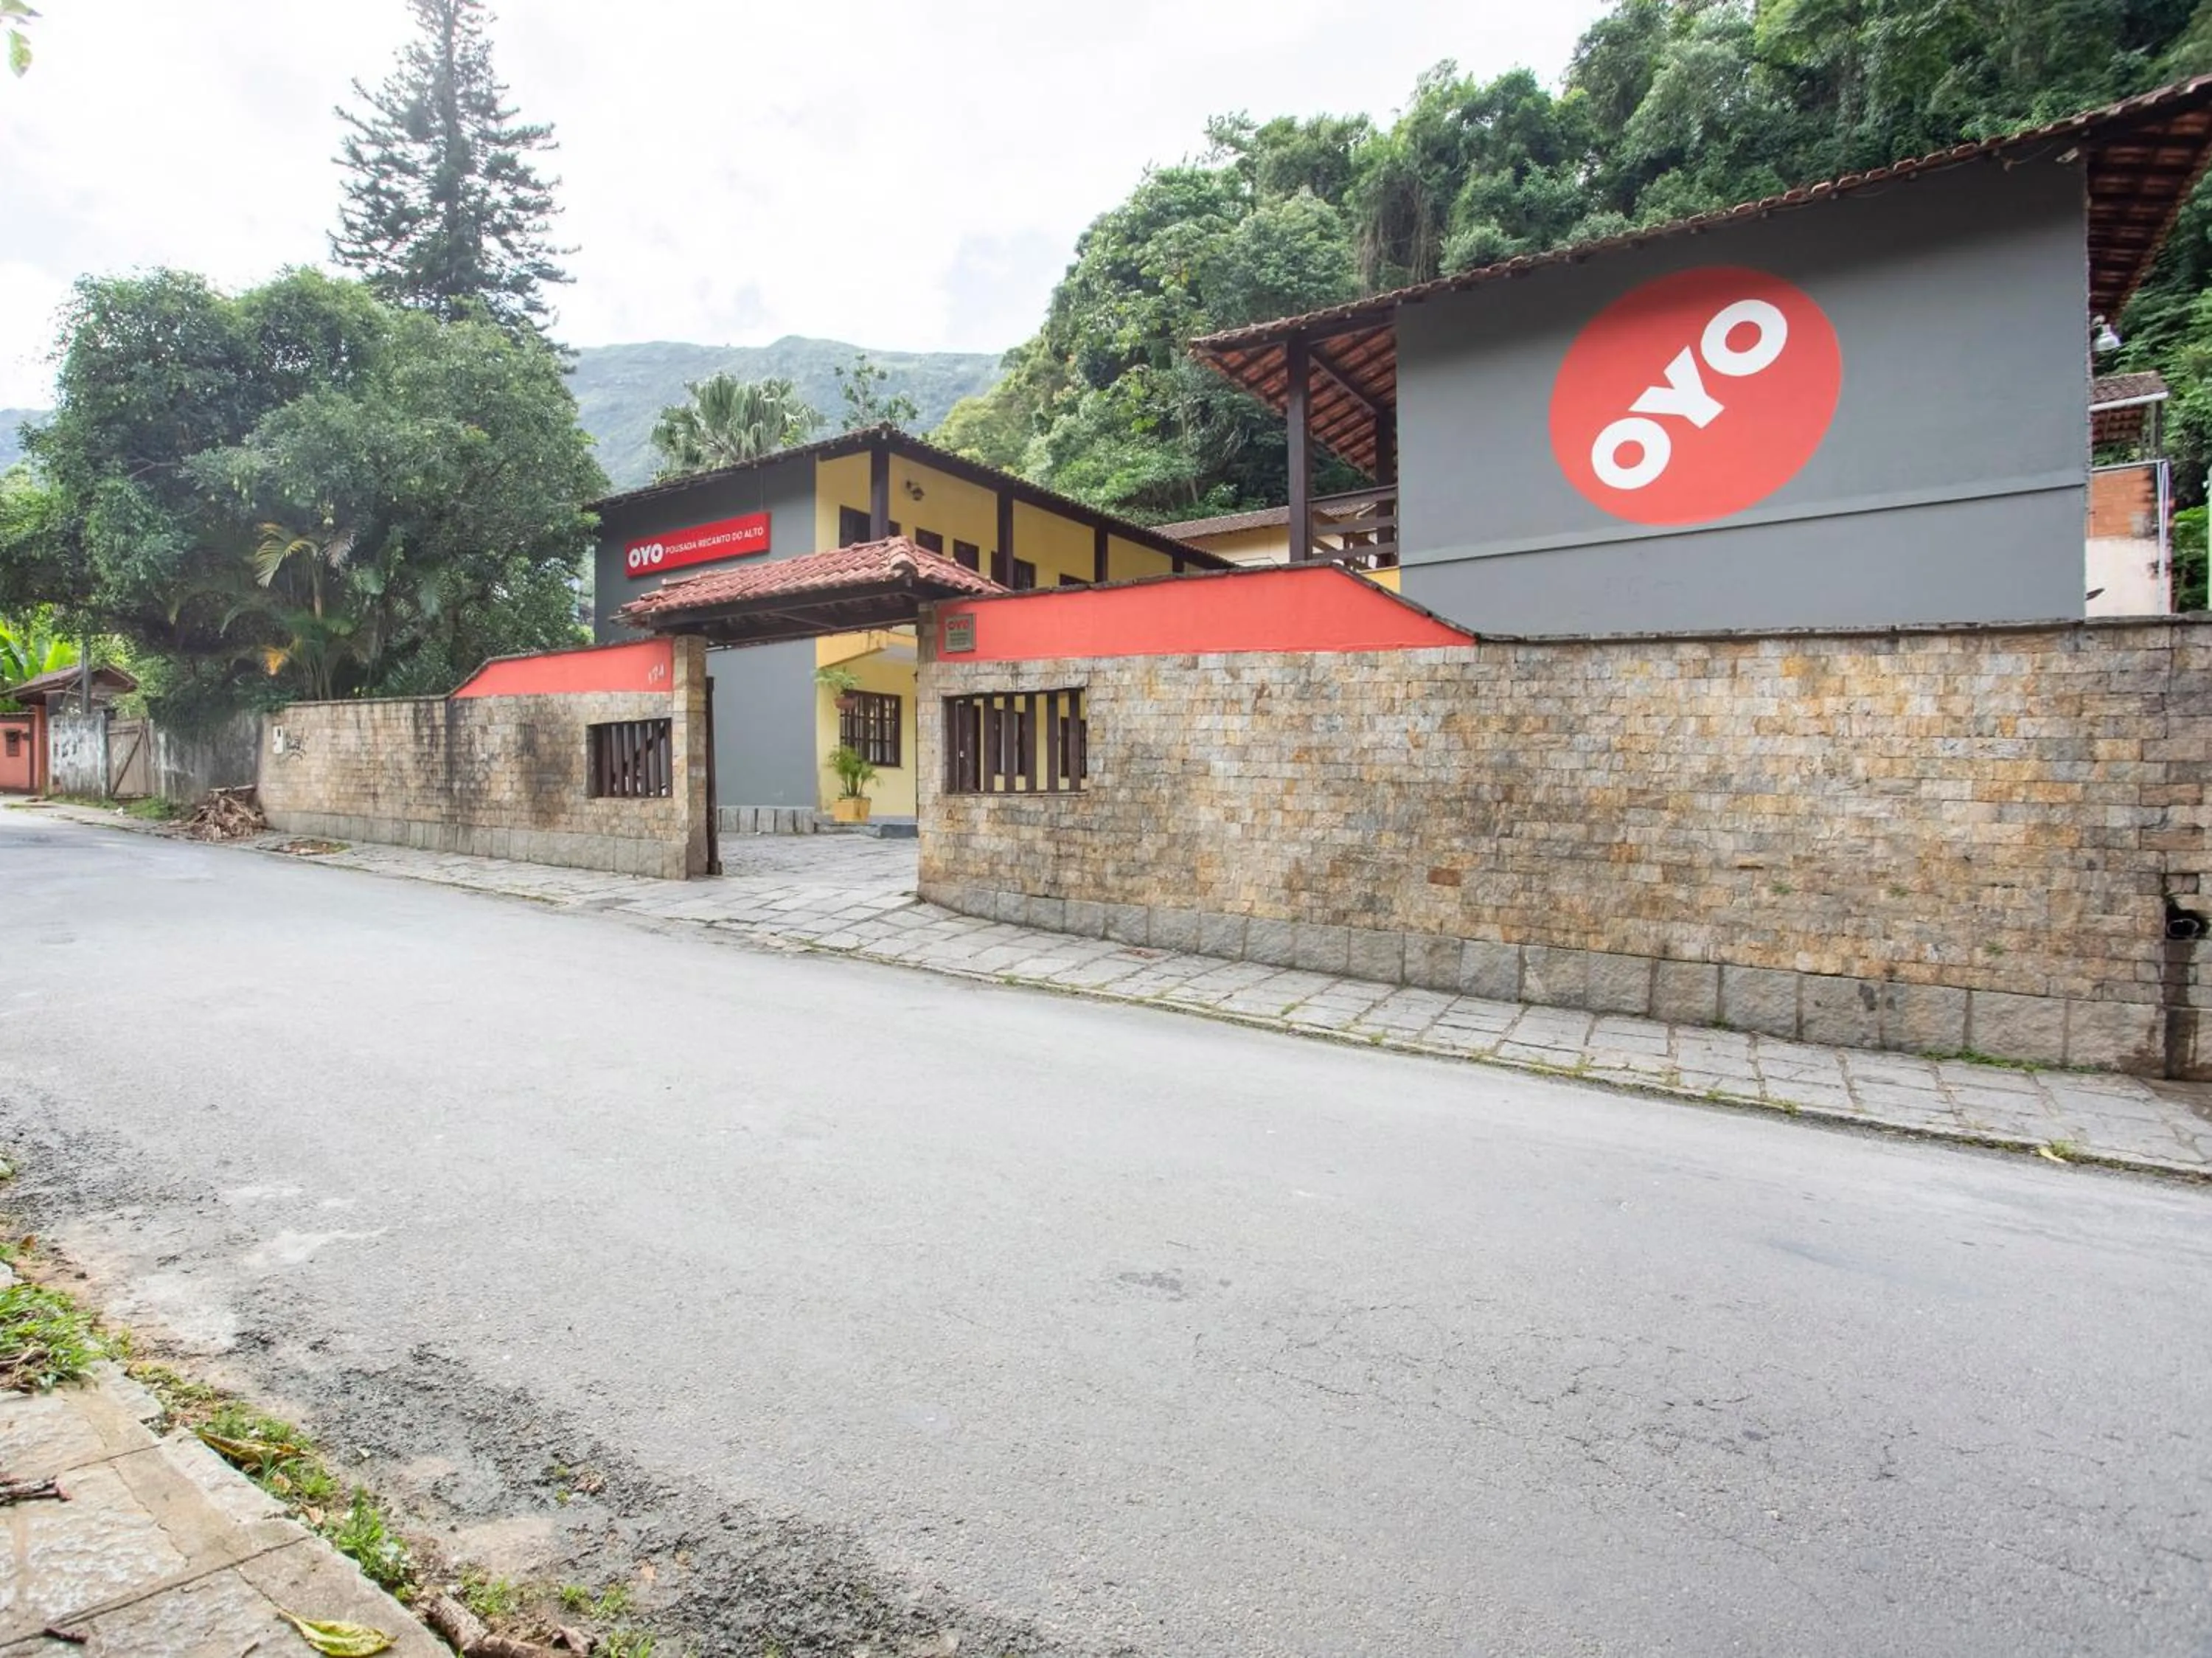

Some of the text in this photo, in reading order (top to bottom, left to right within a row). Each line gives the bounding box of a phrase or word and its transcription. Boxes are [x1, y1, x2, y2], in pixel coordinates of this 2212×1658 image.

[1591, 299, 1788, 490] OYO
[628, 526, 764, 568] OYO POUSADA RECANTO DO ALTO
